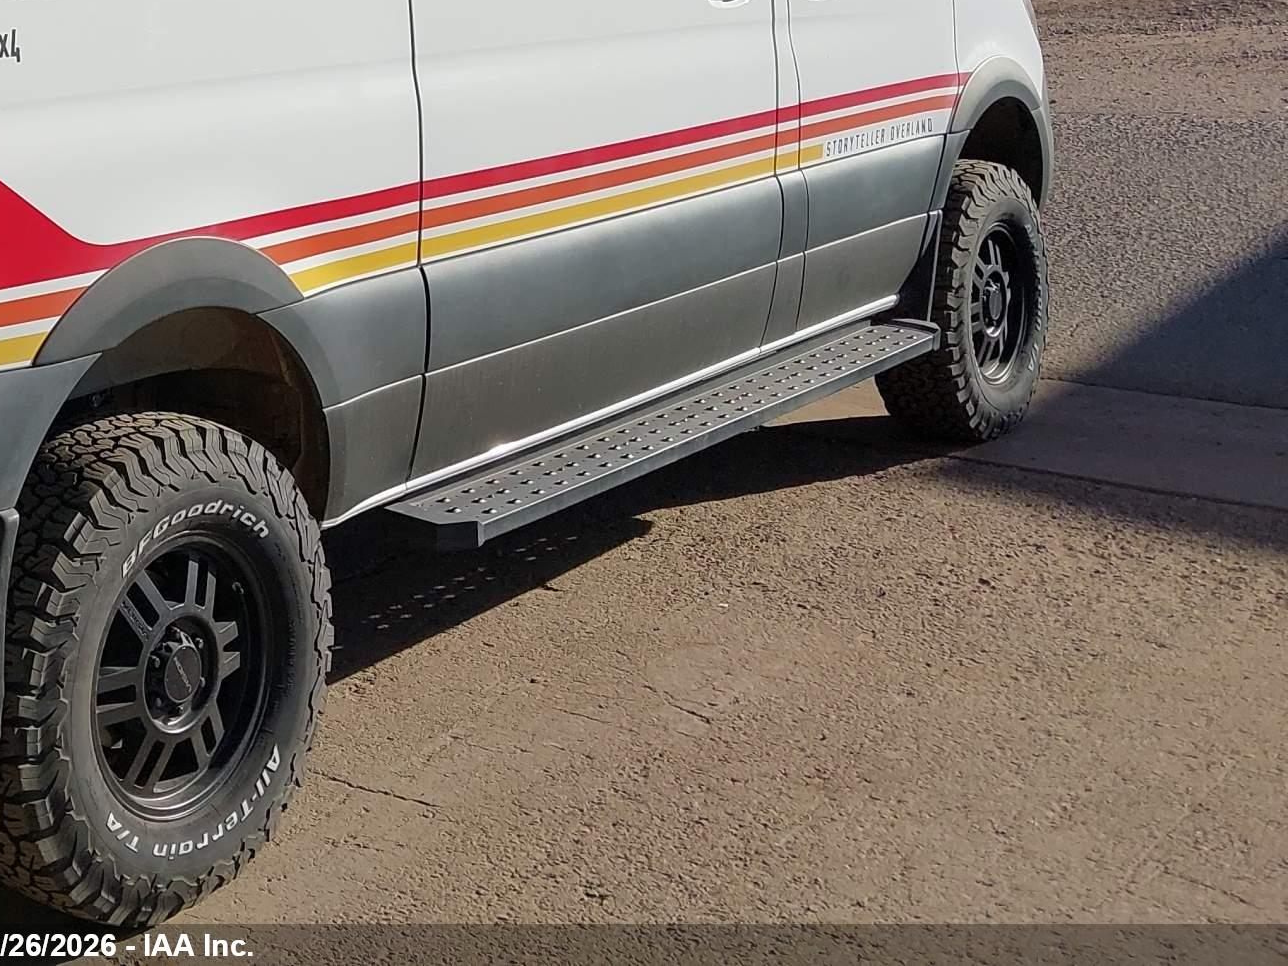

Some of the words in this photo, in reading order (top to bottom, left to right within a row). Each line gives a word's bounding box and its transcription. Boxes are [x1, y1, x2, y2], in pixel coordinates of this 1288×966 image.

[826, 128, 886, 157] STORYTELLER
[890, 117, 933, 141] OVERLAND
[122, 499, 270, 578] BFGoodrich
[106, 811, 140, 853] T/A
[152, 744, 281, 861] All-Terrain
